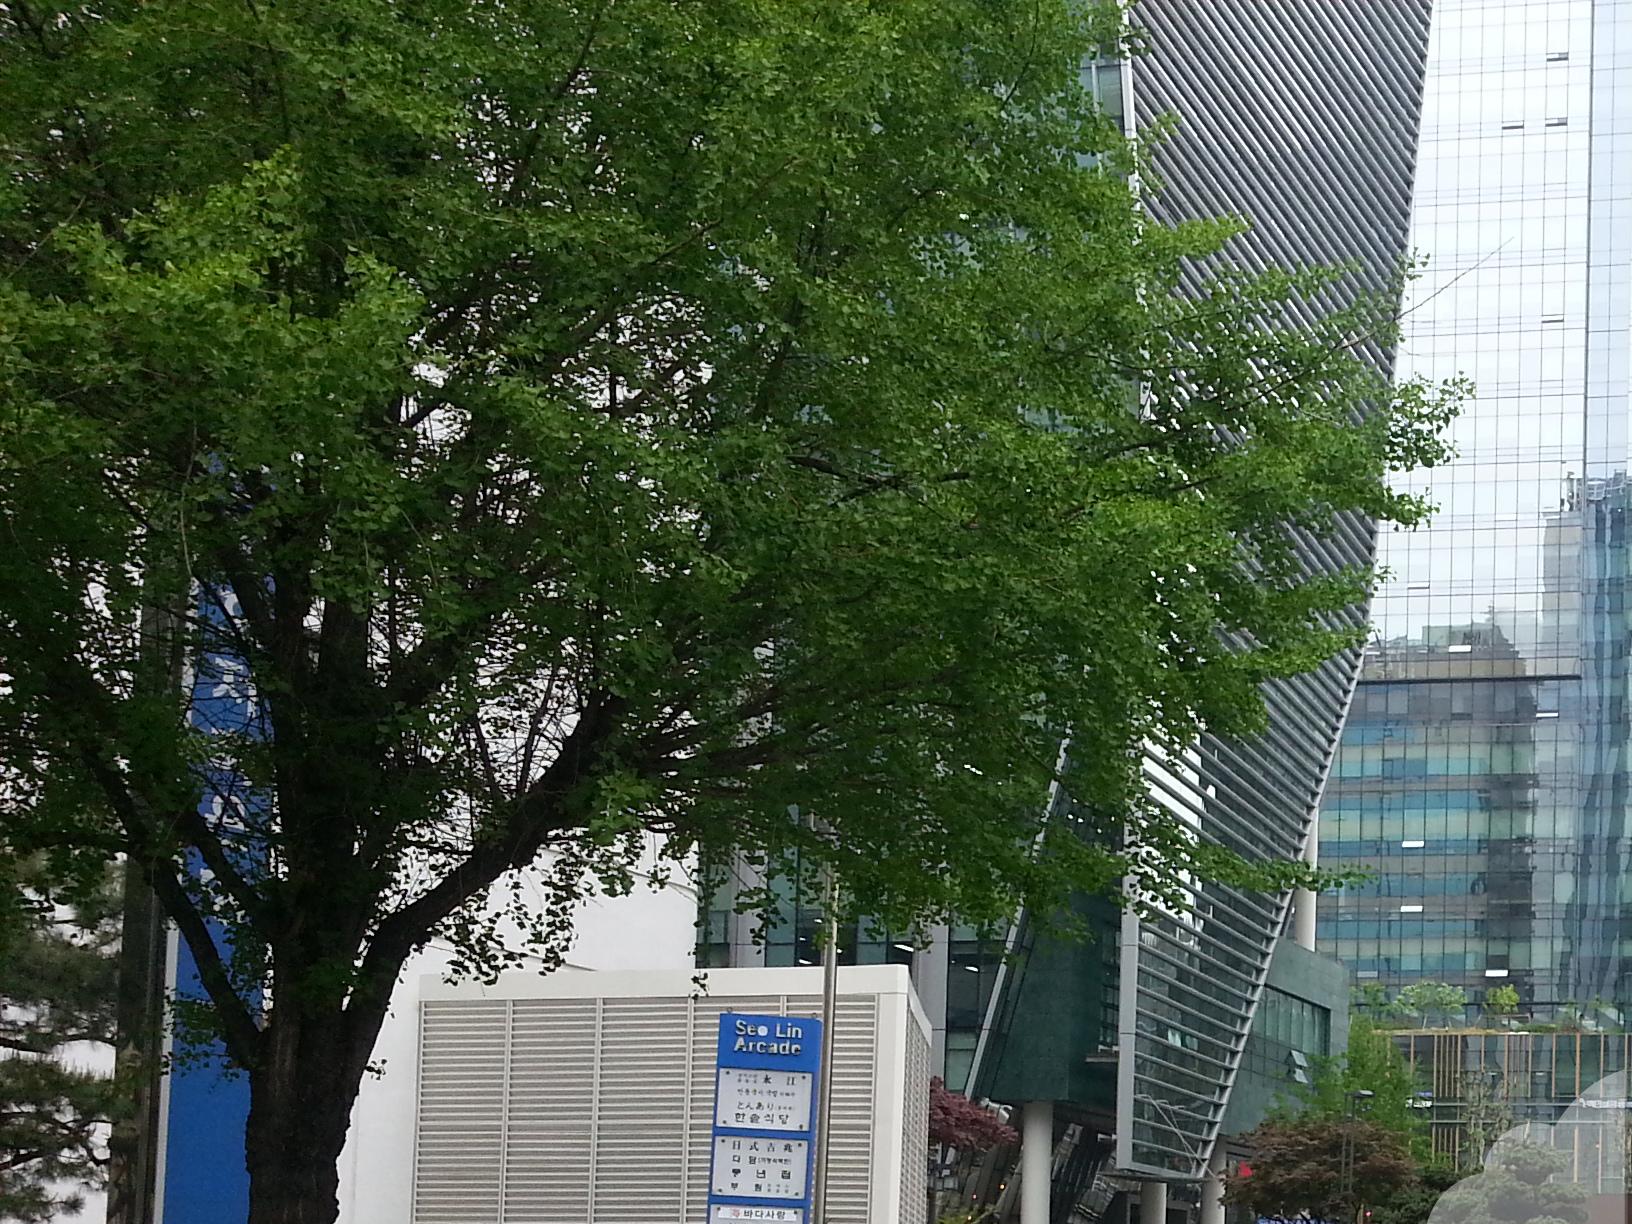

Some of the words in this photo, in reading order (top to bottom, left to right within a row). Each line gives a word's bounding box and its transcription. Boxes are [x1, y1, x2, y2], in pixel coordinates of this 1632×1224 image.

[735, 1019, 768, 1036] Seo
[776, 1022, 802, 1038] Lin
[733, 1037, 802, 1055] Arcade
[743, 1209, 786, 1220] 바다사랑
